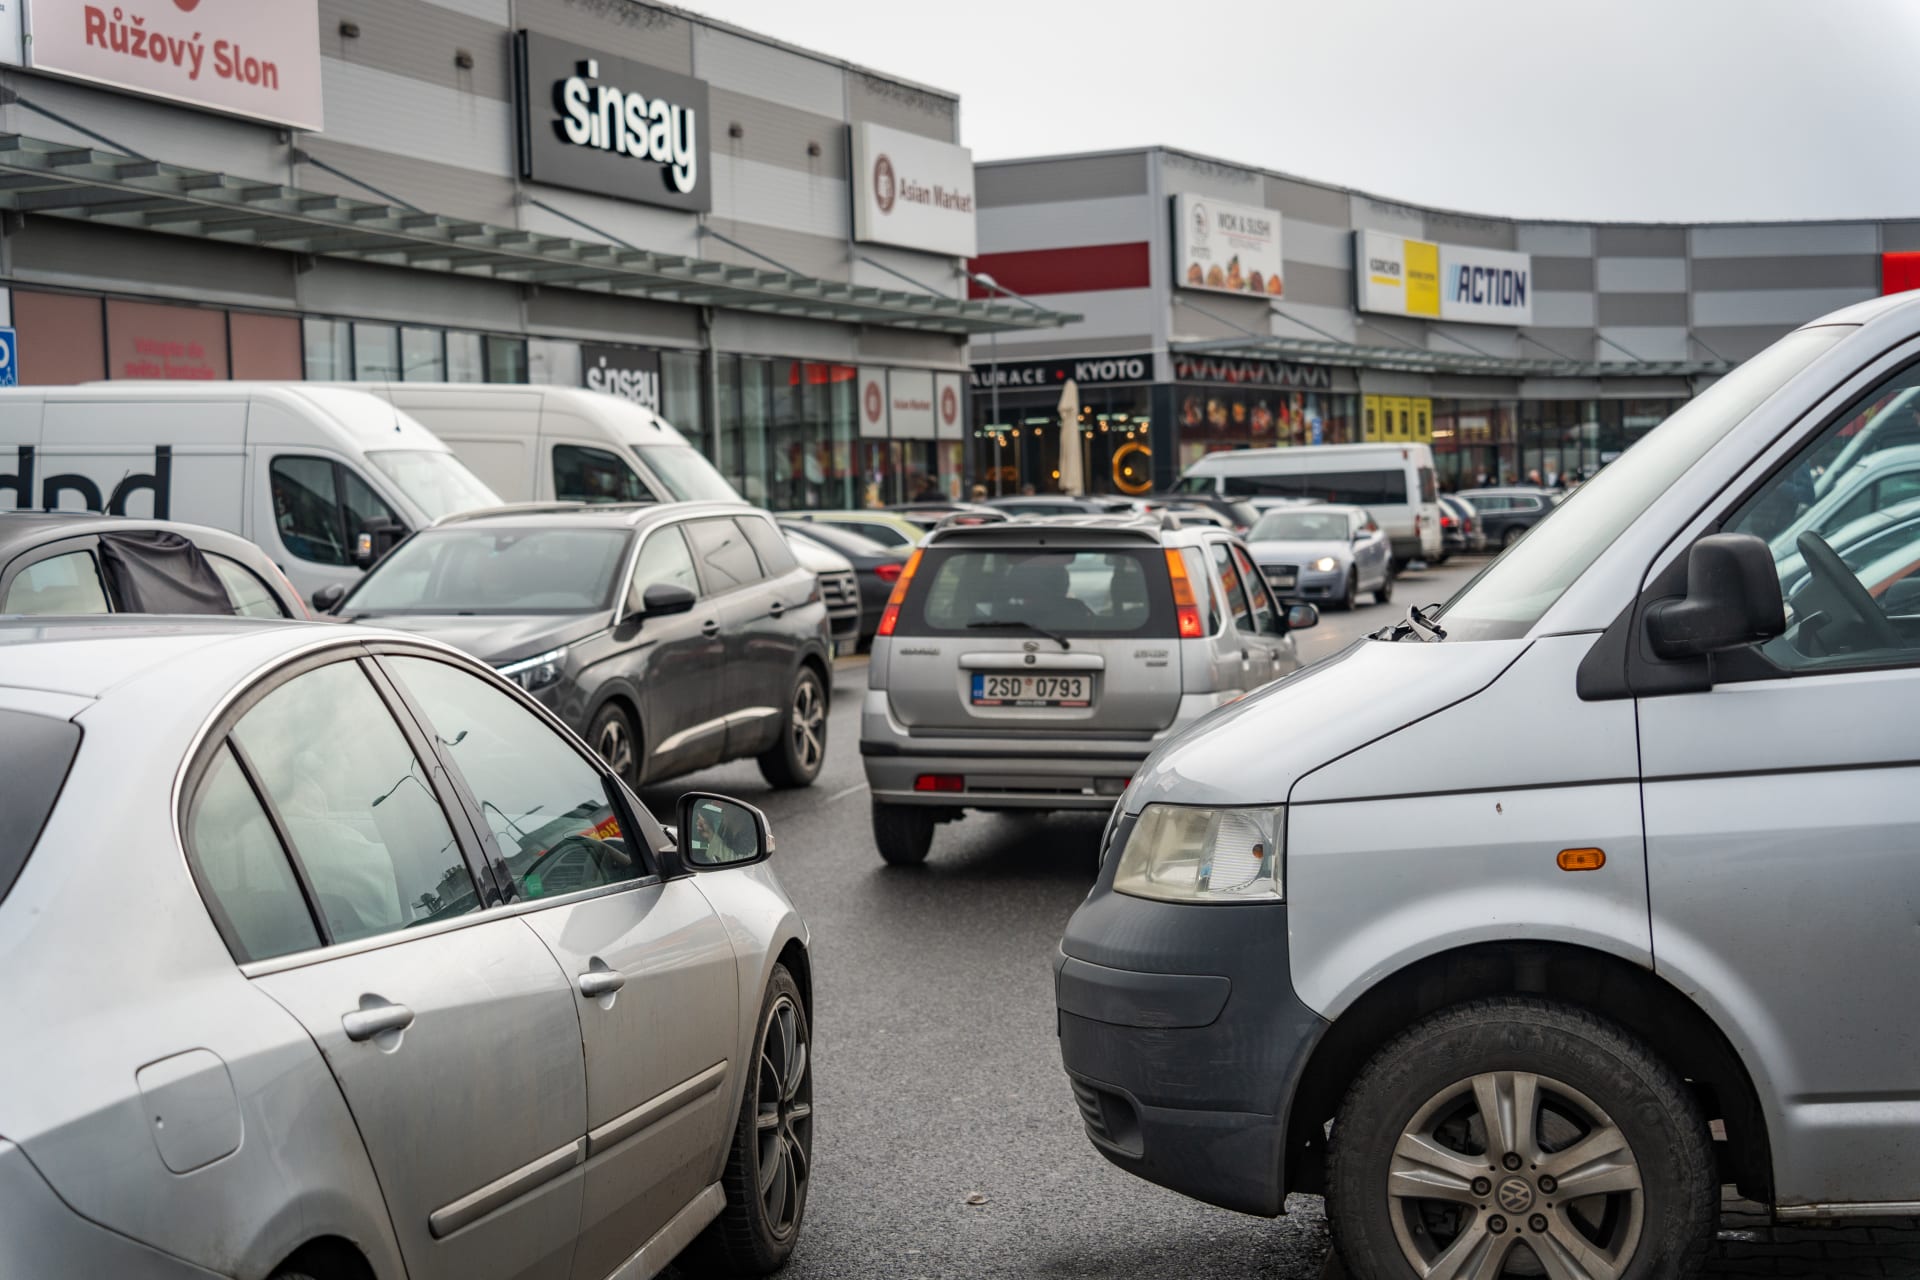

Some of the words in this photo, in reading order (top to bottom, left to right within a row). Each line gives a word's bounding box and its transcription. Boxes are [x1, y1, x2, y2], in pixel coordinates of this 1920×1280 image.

[84, 5, 205, 81] Růžový
[213, 39, 279, 91] Slon
[564, 58, 698, 194] sinsay
[899, 178, 931, 206] Asian
[932, 184, 973, 214] Market
[1457, 264, 1527, 308] ACTION
[1075, 358, 1145, 382] KYOTO
[988, 678, 1022, 698] 2SD
[1036, 678, 1082, 698] 0793
